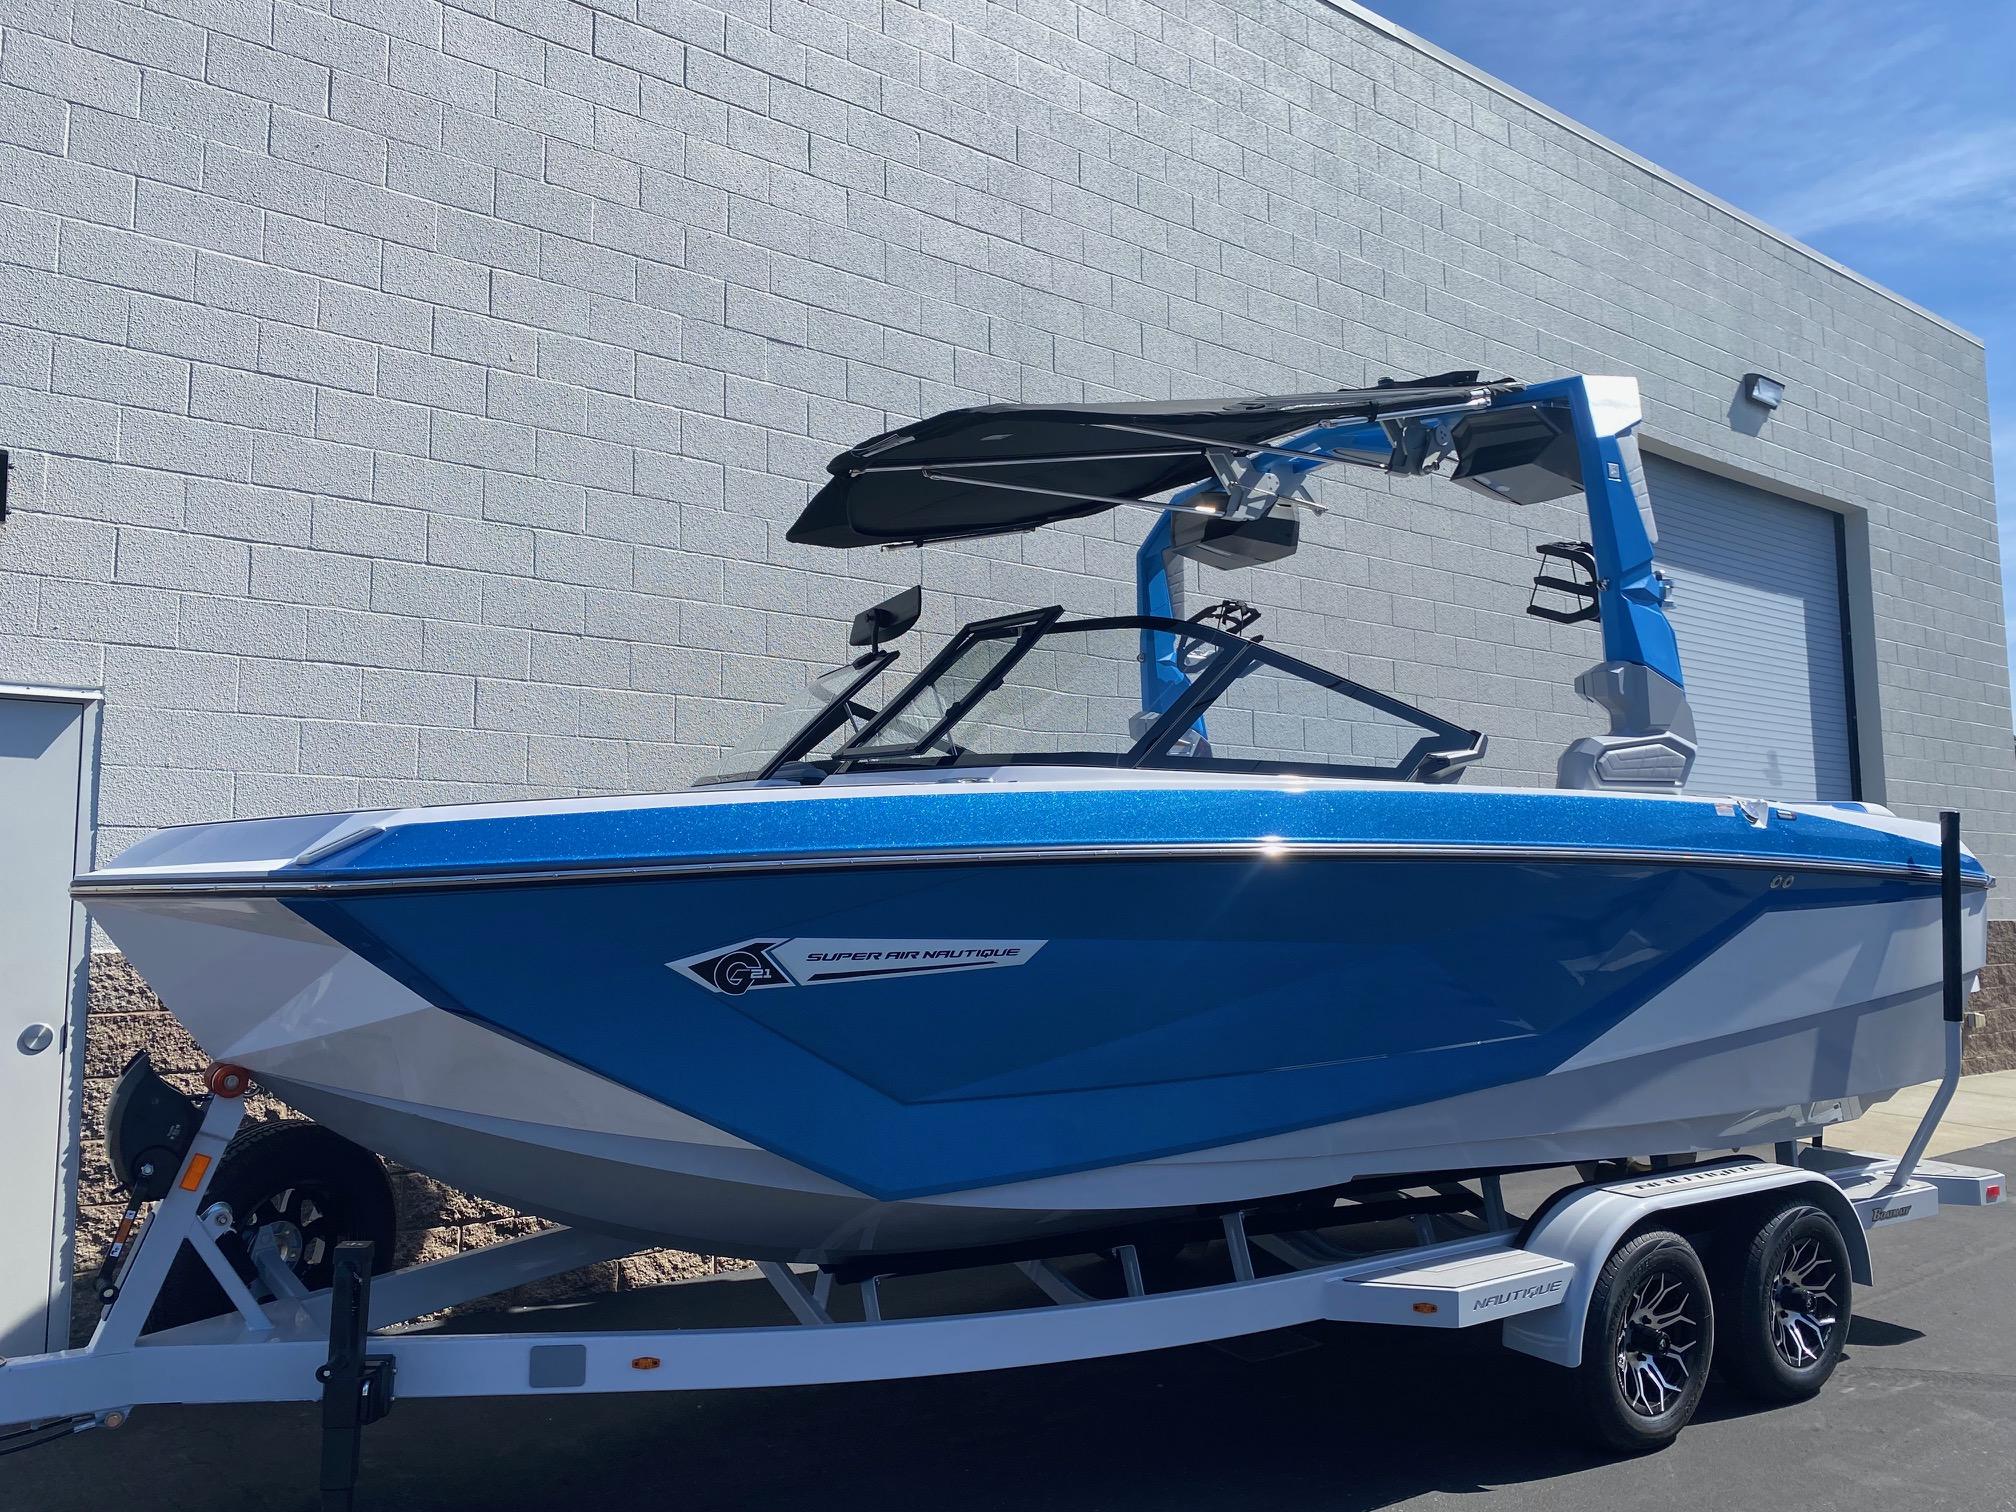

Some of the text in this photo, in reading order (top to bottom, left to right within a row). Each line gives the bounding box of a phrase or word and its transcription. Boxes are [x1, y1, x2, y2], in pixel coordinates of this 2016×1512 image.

[805, 947, 1022, 962] SUPER AIR NAUTIQUE
[1473, 1280, 1563, 1311] NAUTIQUE
